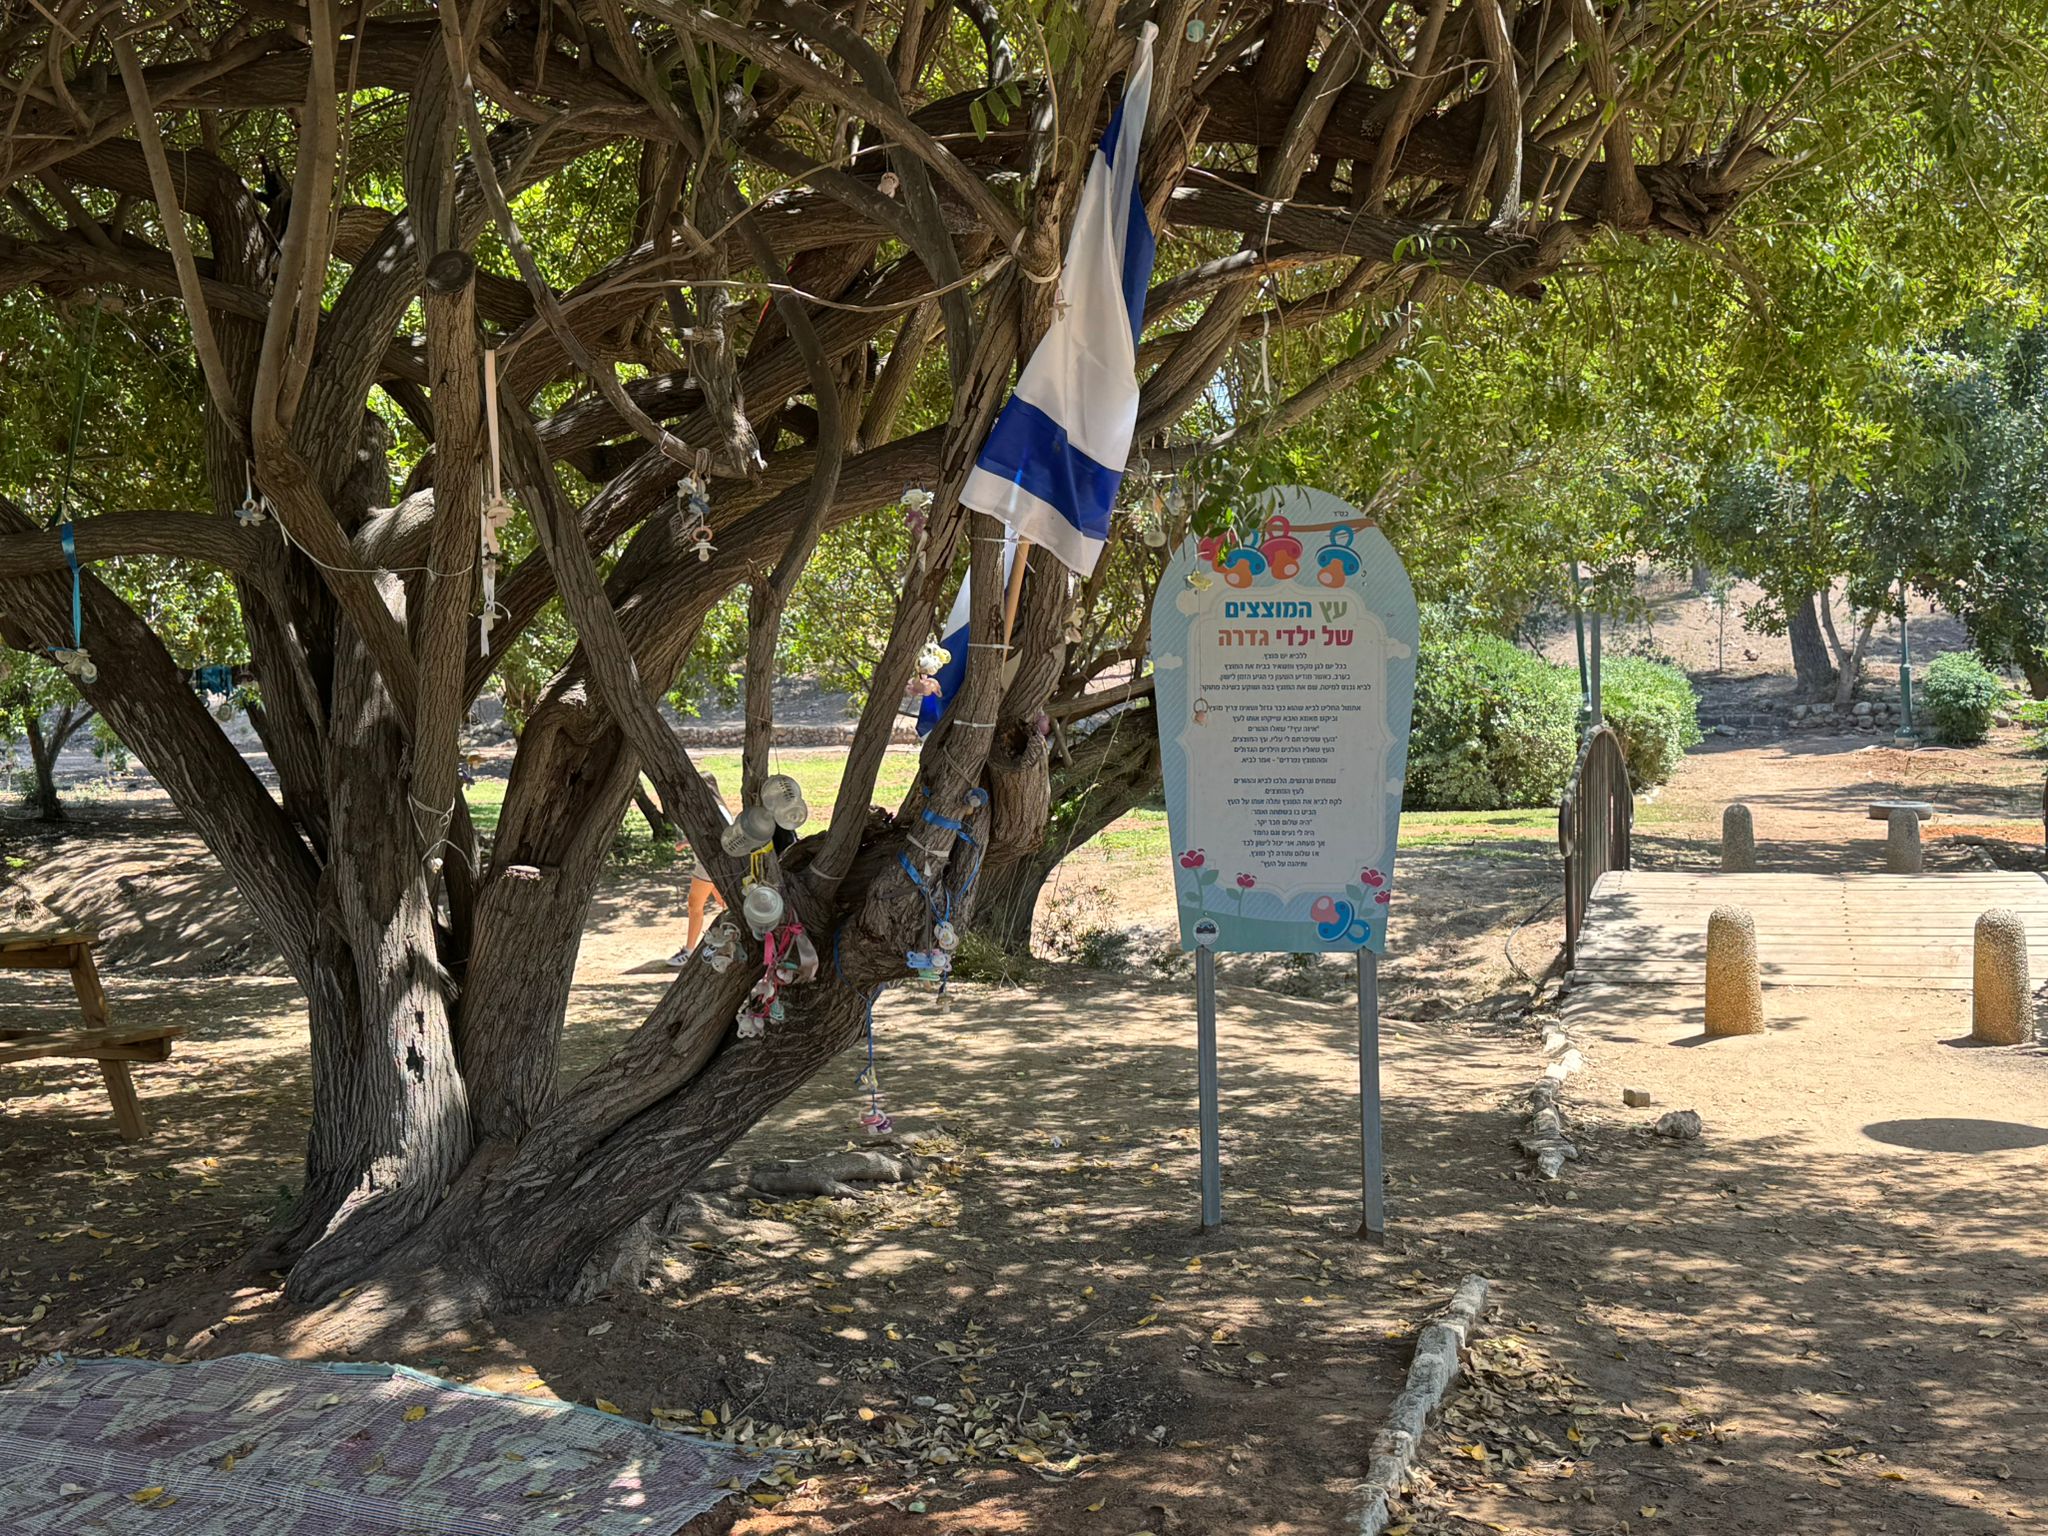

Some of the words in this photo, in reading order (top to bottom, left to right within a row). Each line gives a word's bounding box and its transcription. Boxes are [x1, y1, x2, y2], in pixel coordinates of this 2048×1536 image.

[1225, 601, 1312, 618] המוצצים
[1318, 601, 1348, 623] עץ
[1218, 628, 1269, 646] גדרה
[1276, 625, 1315, 646] ילדי
[1322, 625, 1354, 646] של
